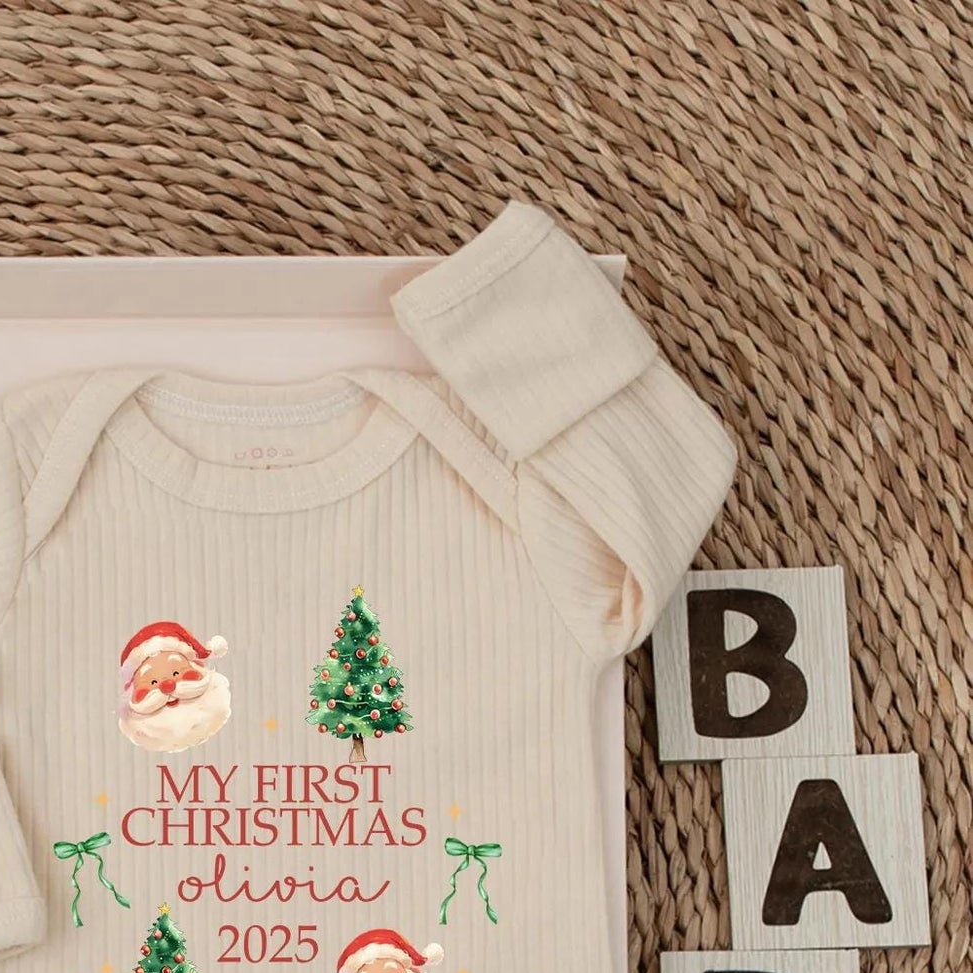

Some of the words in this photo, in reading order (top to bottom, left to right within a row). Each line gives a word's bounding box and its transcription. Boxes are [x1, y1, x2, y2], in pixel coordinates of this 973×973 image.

[156, 765, 238, 803] MY
[252, 764, 391, 803] FIRST
[121, 807, 427, 847] CHRISTMAS
[177, 853, 391, 903] olivia
[217, 924, 319, 963] 2025
